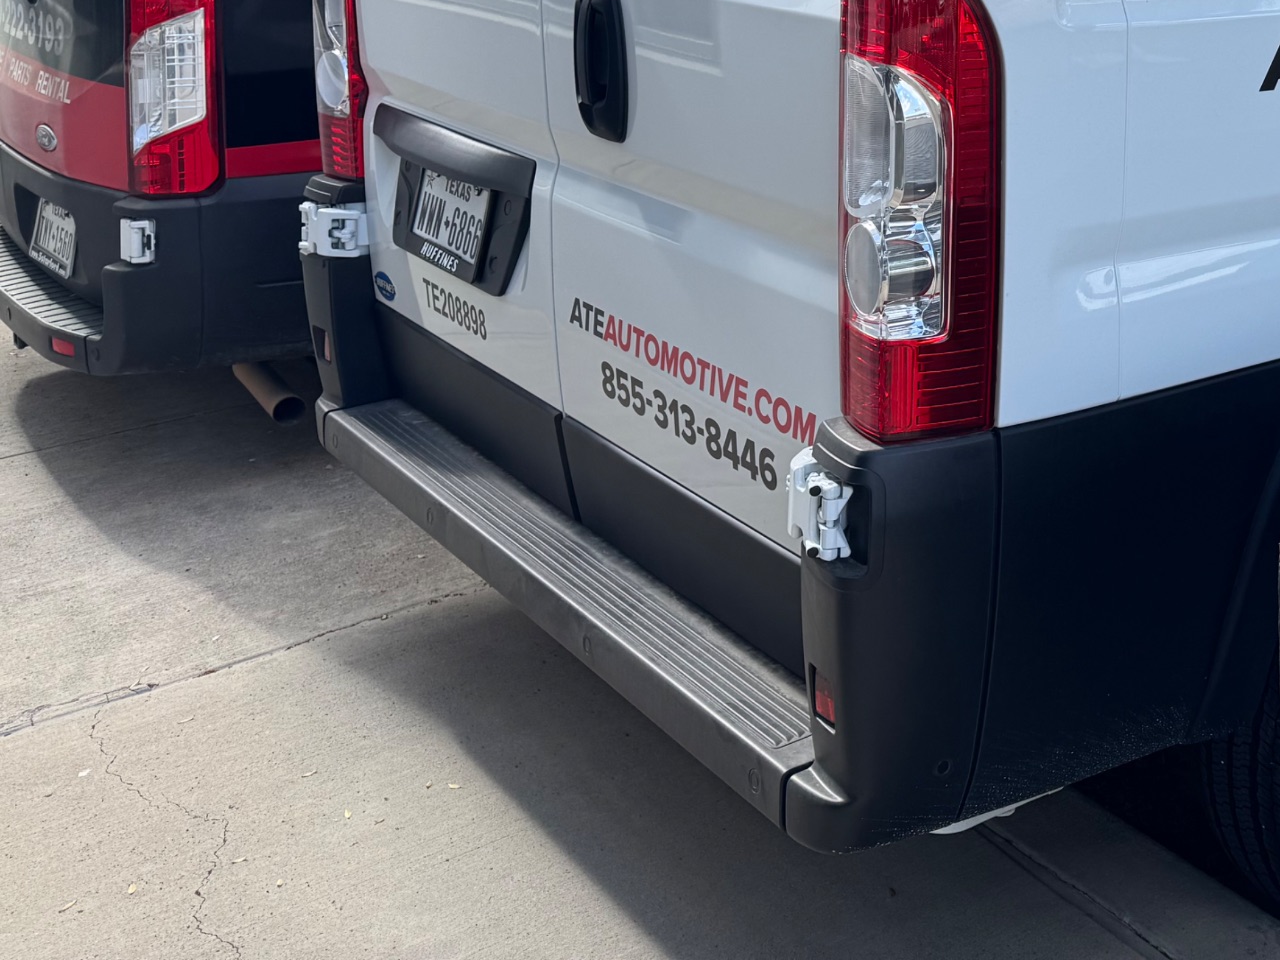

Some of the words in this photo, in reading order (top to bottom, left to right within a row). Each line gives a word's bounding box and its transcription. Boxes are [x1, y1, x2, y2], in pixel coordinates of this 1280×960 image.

[8, 57, 32, 86] PARTS
[35, 69, 71, 104] RENTAL
[445, 179, 471, 203] TEXAS
[420, 241, 460, 273] HUFFINES
[448, 206, 483, 260] 6866
[423, 277, 487, 341] TE208898
[569, 297, 817, 447] ATEAUTOMOTIVE.COM
[601, 361, 778, 491] 855-313-8446
